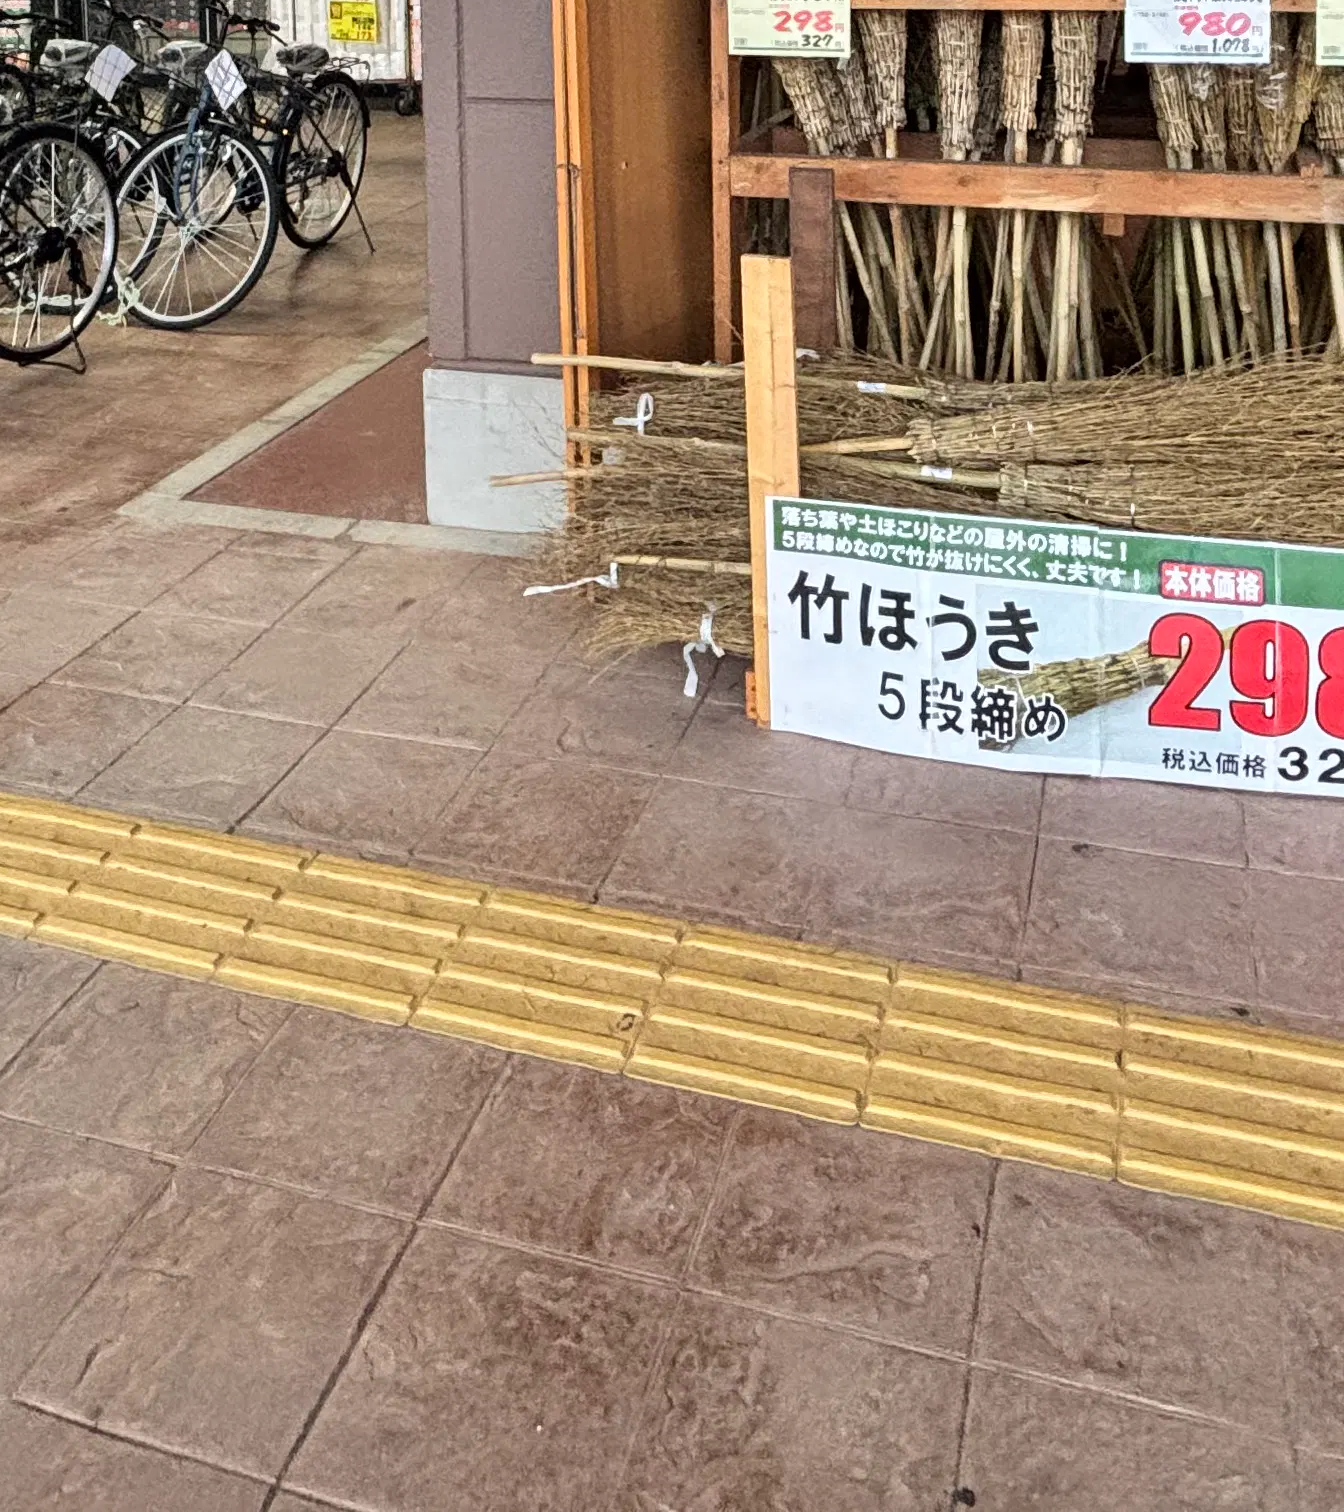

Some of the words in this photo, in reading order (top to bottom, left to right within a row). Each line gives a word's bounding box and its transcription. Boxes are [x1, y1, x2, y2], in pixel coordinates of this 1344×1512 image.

[1164, 566, 1261, 603] 本体価格
[787, 570, 1039, 671] 竹ほうき
[877, 671, 1067, 742] 5段締め
